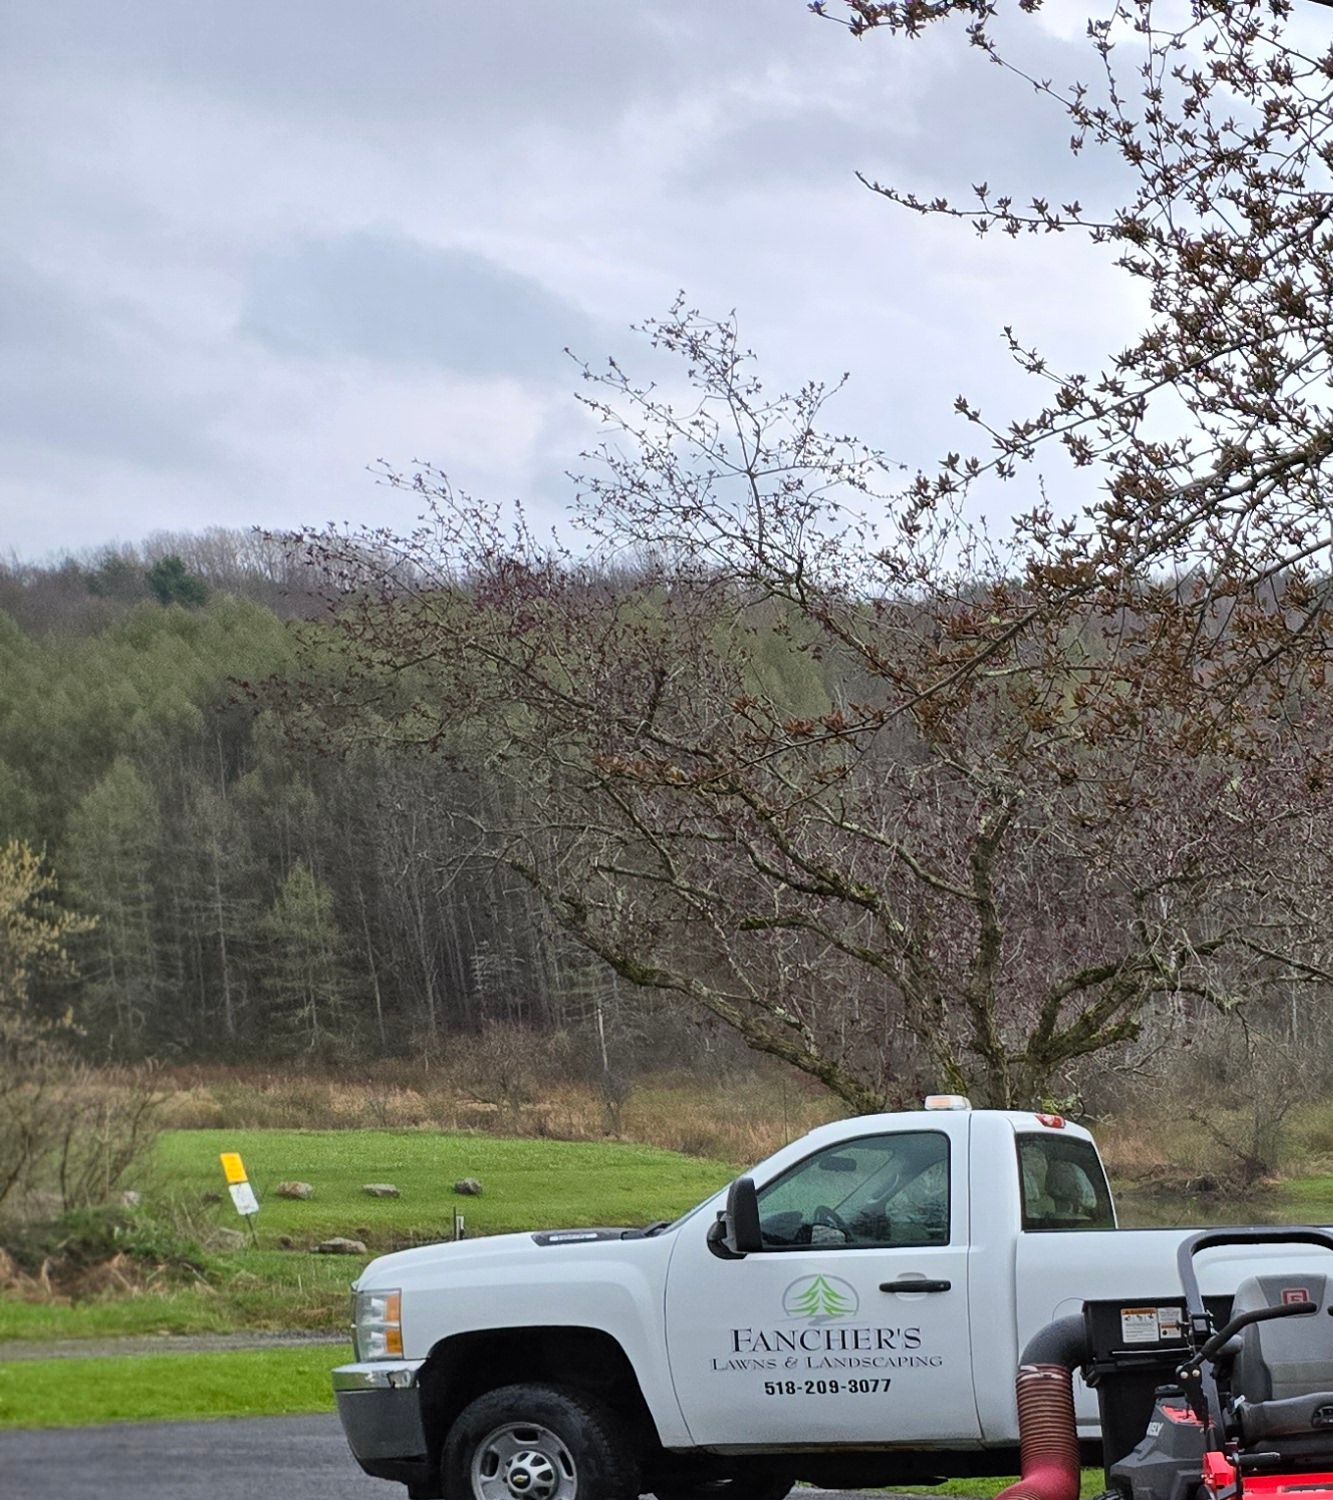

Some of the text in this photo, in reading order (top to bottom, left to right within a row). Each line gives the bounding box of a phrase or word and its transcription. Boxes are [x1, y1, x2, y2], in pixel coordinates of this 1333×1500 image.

[729, 1327, 923, 1352] FANCHER'S
[711, 1355, 943, 1371] LAWNS & LANDSCAPING
[764, 1378, 892, 1396] 518-209-3077
